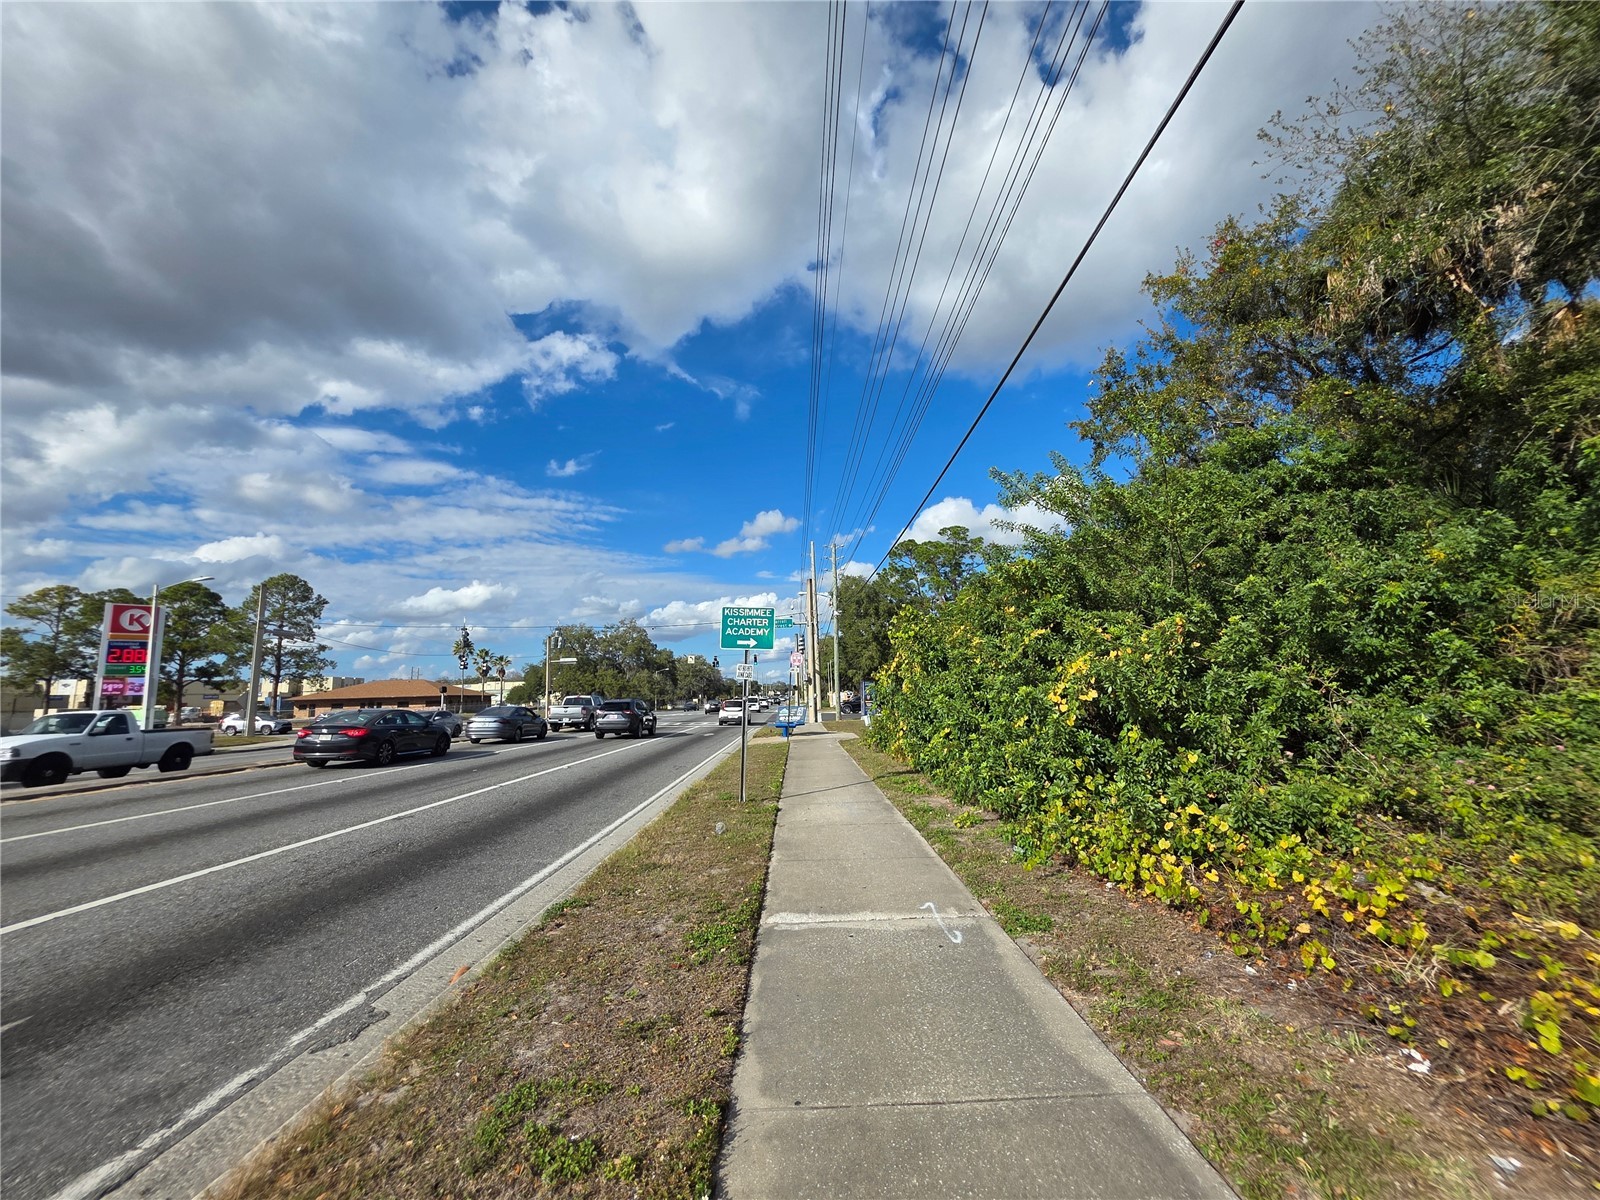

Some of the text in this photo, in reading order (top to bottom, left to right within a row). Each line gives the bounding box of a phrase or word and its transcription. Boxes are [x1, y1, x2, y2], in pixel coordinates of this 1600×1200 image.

[724, 608, 772, 617] KISSIMMEE
[128, 613, 149, 629] K
[727, 618, 769, 626] CHARTER
[725, 628, 770, 636] ACADEMY
